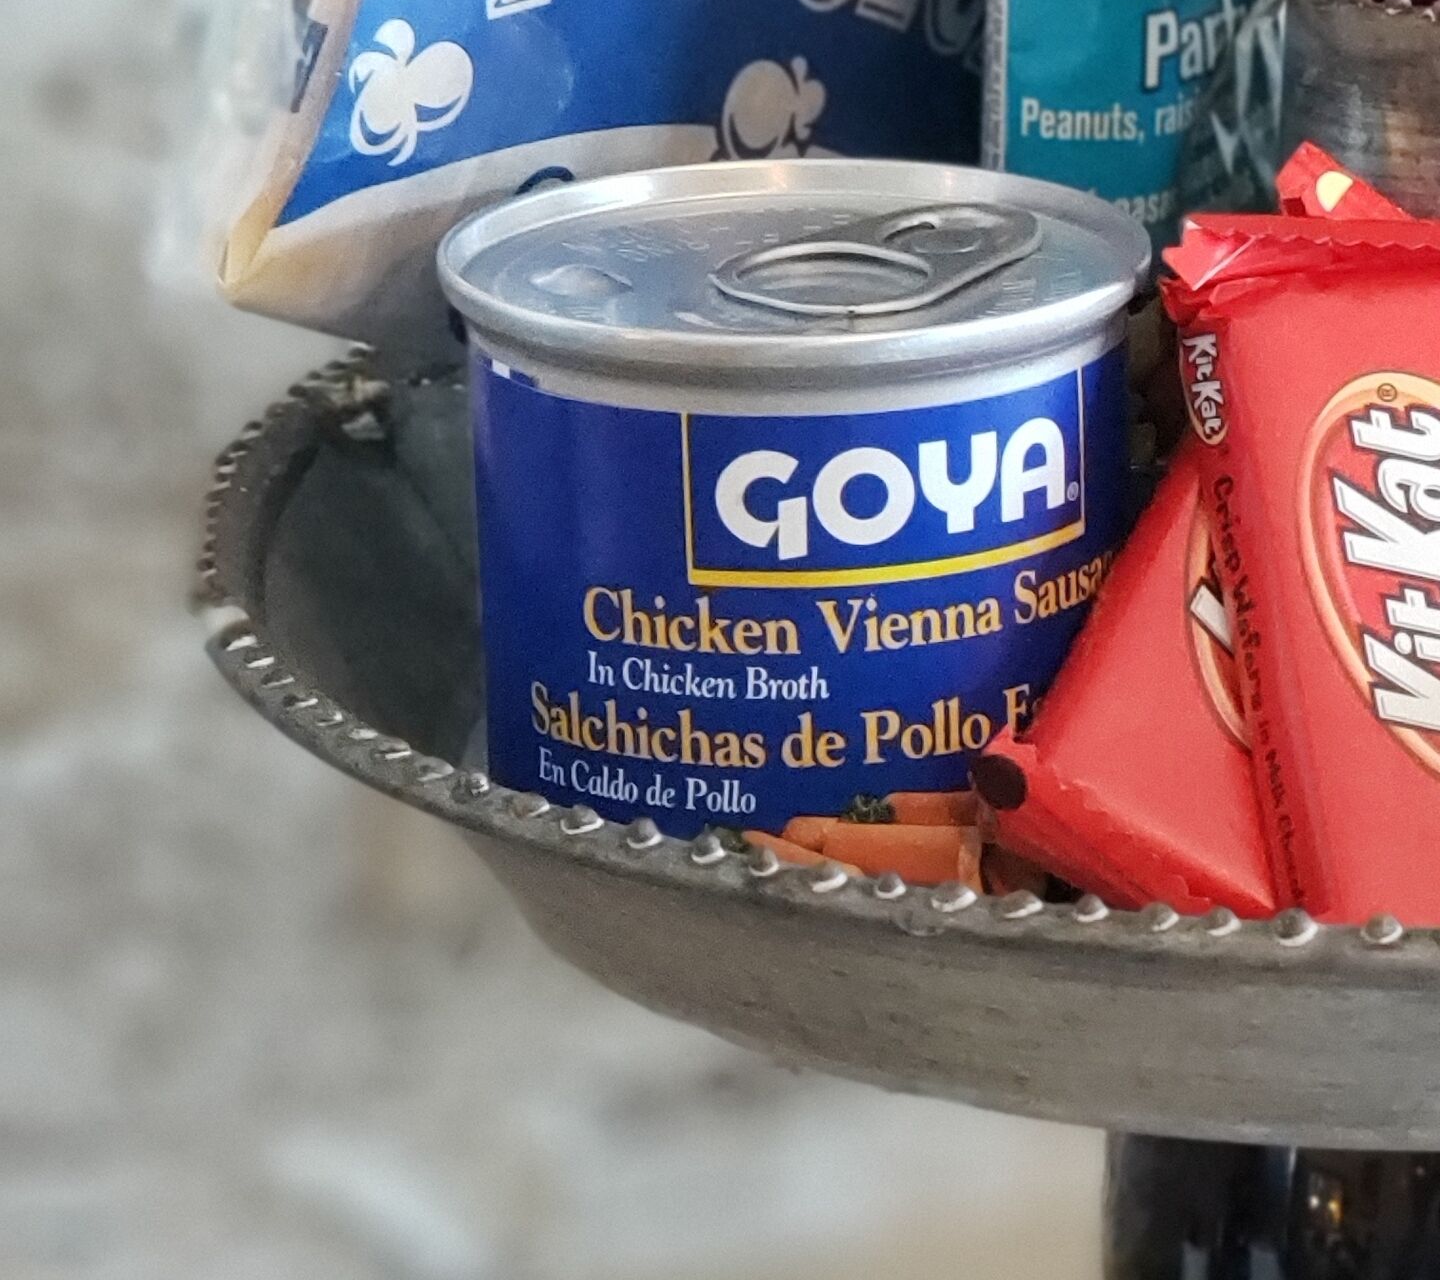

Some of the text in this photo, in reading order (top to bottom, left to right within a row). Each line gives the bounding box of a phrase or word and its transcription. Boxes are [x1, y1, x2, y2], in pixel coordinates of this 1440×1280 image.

[1020, 96, 1146, 146] Peanuts,
[714, 416, 1067, 561] GOYA
[1213, 474, 1242, 573] Crisp
[582, 585, 802, 656] Chicken
[814, 593, 1004, 654] Vienna
[587, 650, 831, 701] In Chicken Broth
[530, 680, 769, 769] Salchichas
[780, 710, 847, 769] de
[859, 695, 993, 765] Pollo
[538, 745, 757, 815] En Caldo de Pollo
